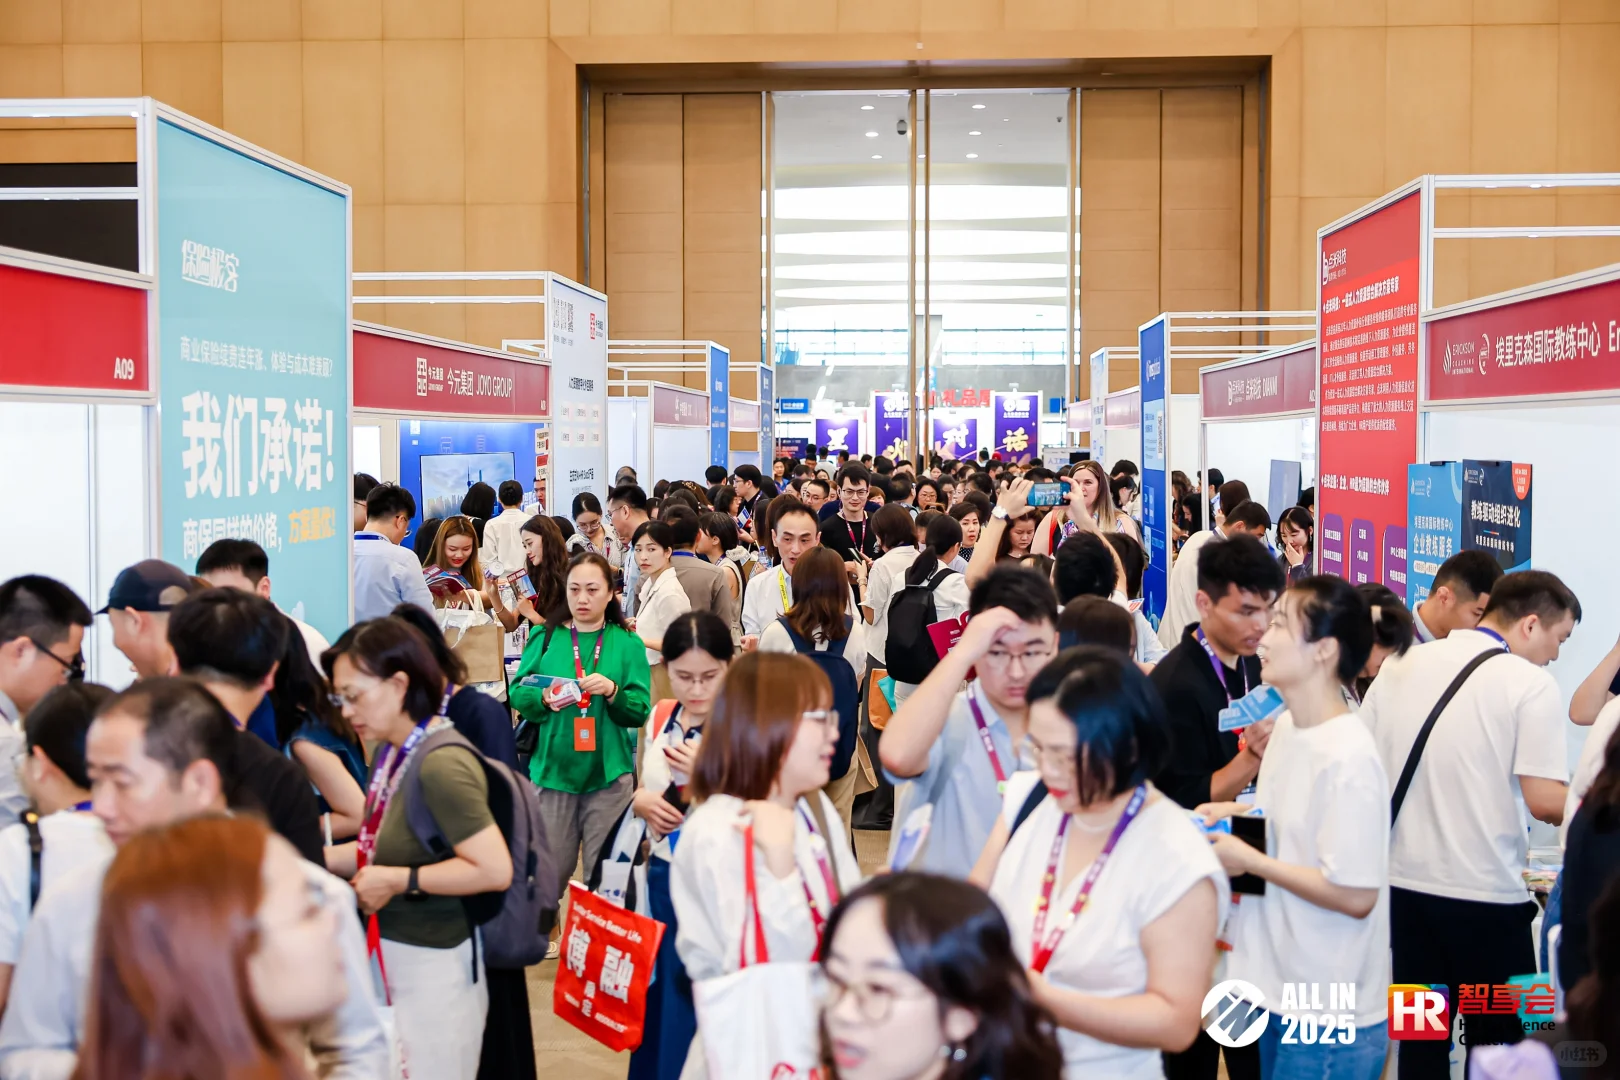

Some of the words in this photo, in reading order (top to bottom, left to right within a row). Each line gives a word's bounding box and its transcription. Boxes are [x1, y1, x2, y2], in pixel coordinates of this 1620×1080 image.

[1452, 342, 1475, 356] ERICKSON
[1495, 321, 1601, 368] 埃里克森国际教练中心
[113, 357, 135, 380] A09
[447, 367, 474, 397] 今元集团
[476, 375, 492, 396] JOYO
[492, 376, 513, 398] GROUP
[1263, 375, 1278, 397] DIANMI
[182, 391, 335, 499] 我们承诺！
[1002, 427, 1029, 452] 话
[1414, 515, 1454, 533] 埃里克森国际教练中心
[1471, 500, 1521, 528] 教练驱动组织进化
[1413, 533, 1453, 558] 企业教练服务
[627, 929, 642, 944] Life
